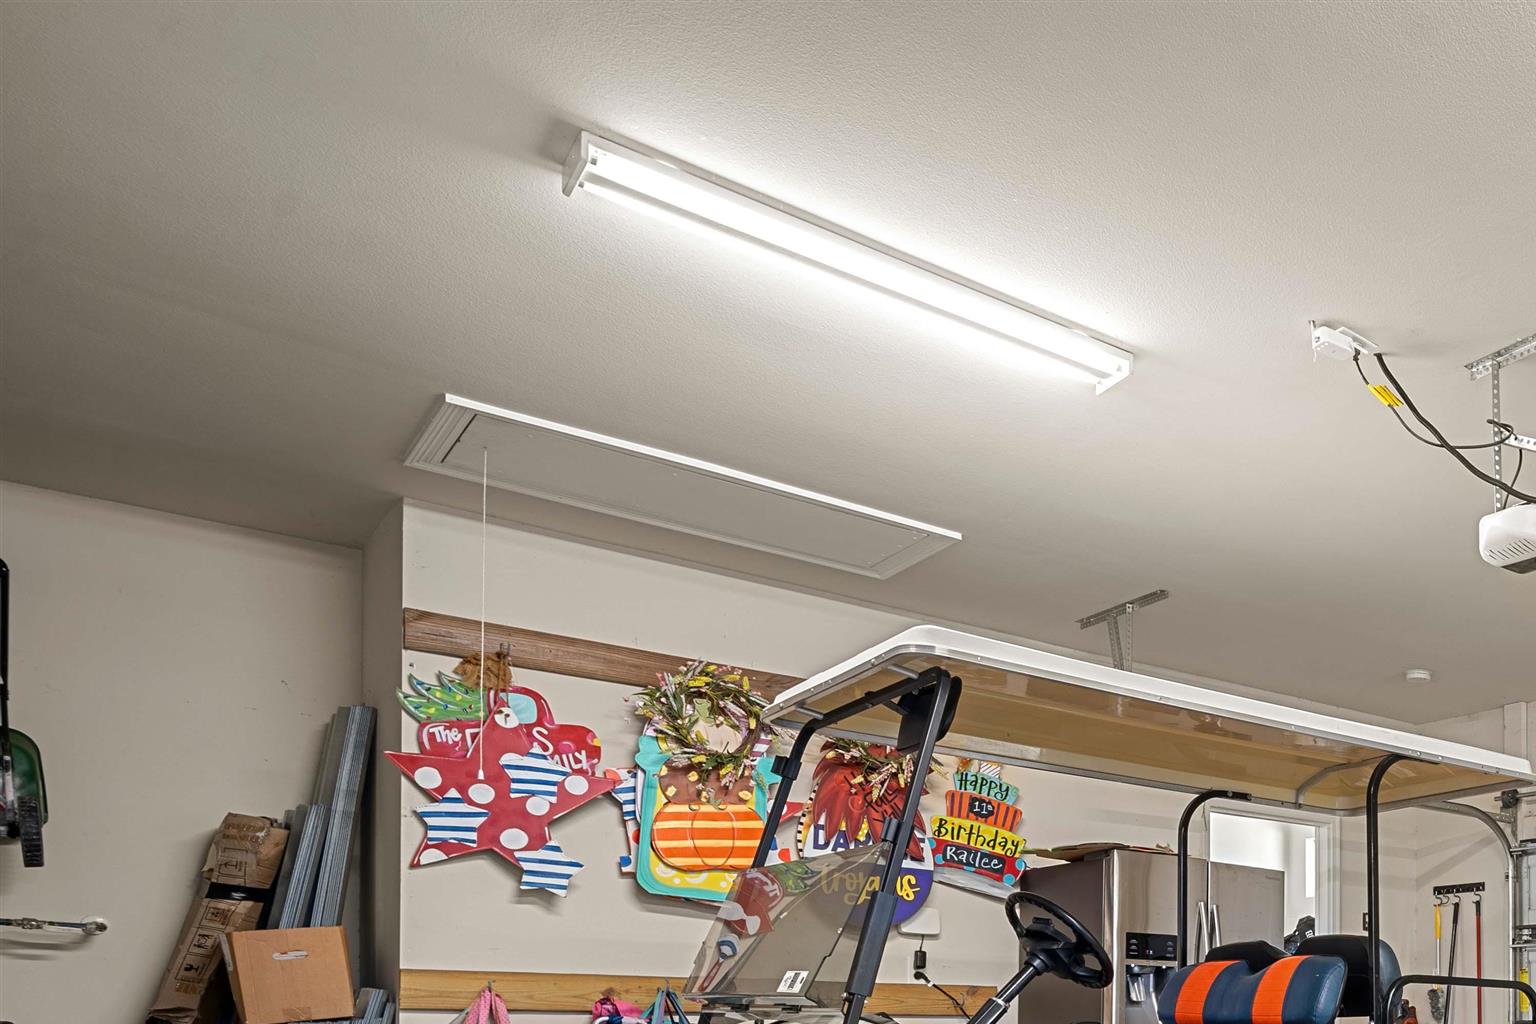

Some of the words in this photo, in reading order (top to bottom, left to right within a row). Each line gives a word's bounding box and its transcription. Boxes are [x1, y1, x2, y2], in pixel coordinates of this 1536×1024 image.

[429, 726, 462, 745] The
[933, 817, 1020, 858] Birthday
[945, 846, 1003, 870] Railee
